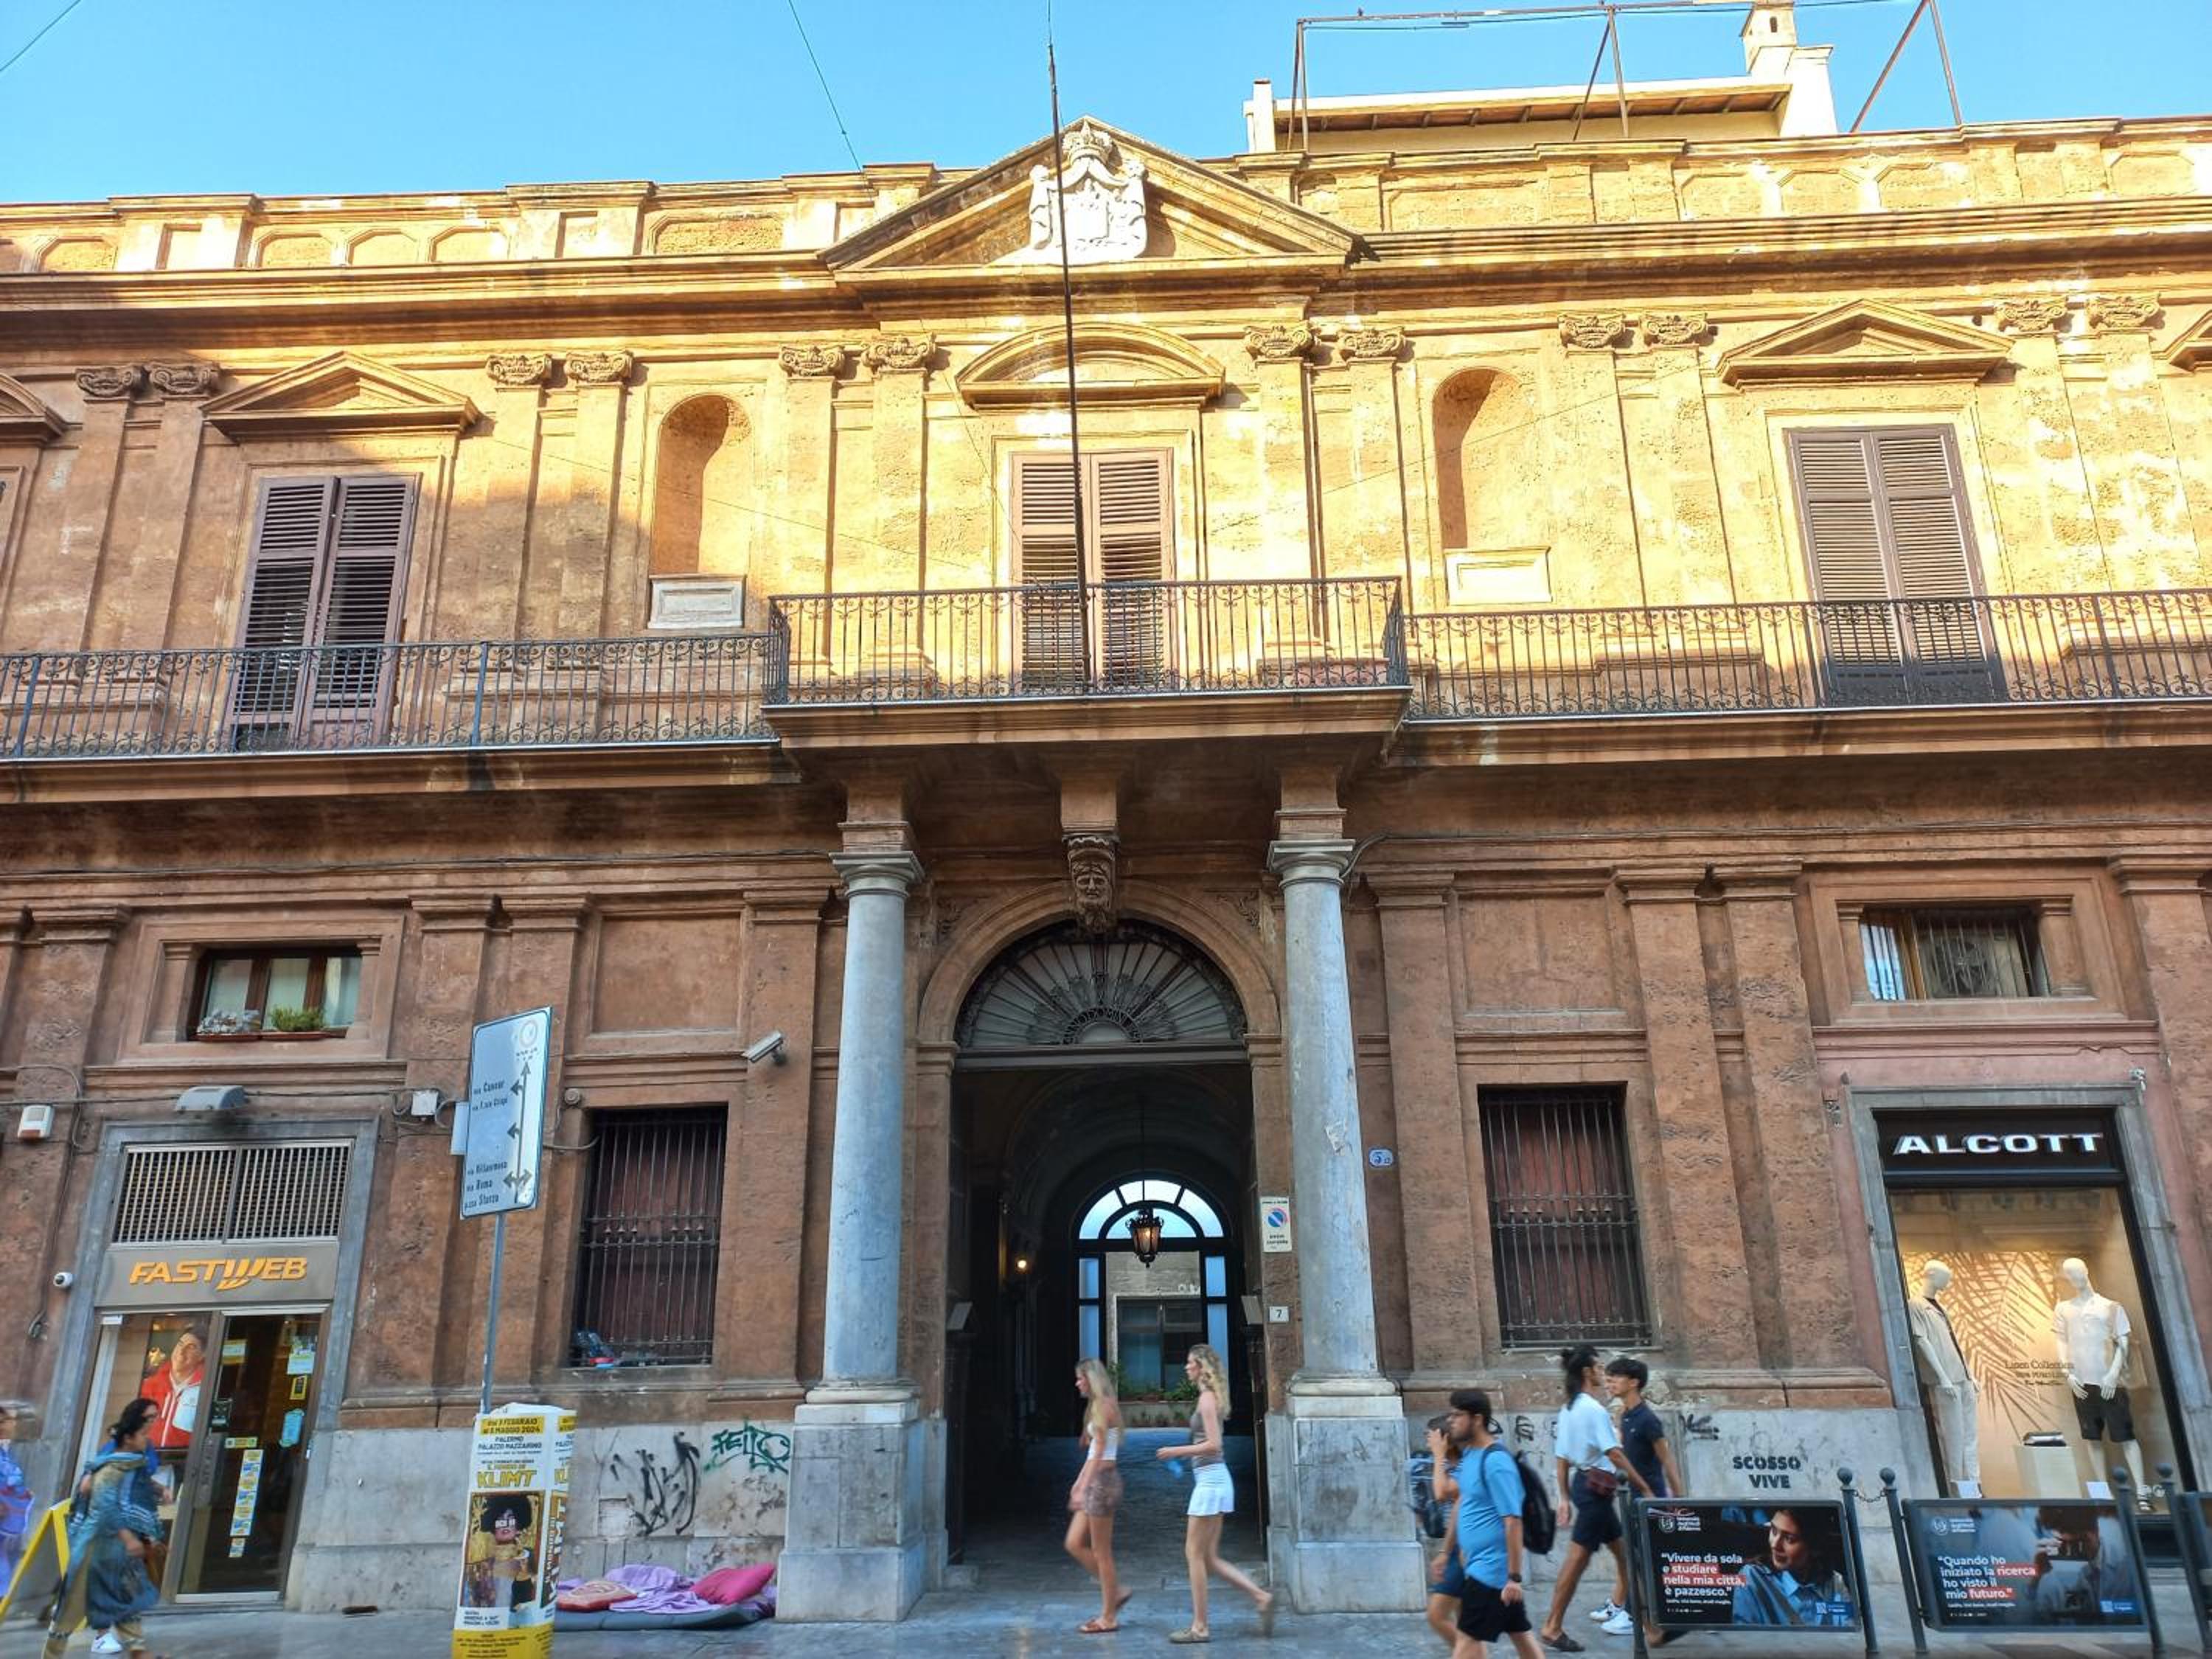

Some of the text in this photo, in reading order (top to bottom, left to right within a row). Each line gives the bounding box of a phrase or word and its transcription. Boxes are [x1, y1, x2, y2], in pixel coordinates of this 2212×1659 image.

[1893, 1133, 2104, 1155] ALCOTT
[129, 1256, 307, 1292] FASTWEB
[1275, 1309, 1283, 1318] 7
[1732, 1455, 1801, 1470] SCOSSO
[477, 1470, 538, 1488] KLIMT
[1748, 1474, 1791, 1489] VIVE
[1703, 1553, 1718, 1563] da
[1720, 1554, 1742, 1563] sola
[1991, 1555, 2006, 1565] ho
[1672, 1564, 1717, 1573] studiare
[1940, 1565, 2036, 1576] iniziato la ricerca
[1664, 1574, 1690, 1585] nella
[1693, 1575, 1714, 1585] mia
[1943, 1576, 1997, 1587] ho visto il
[1946, 1588, 1968, 1599] mio
